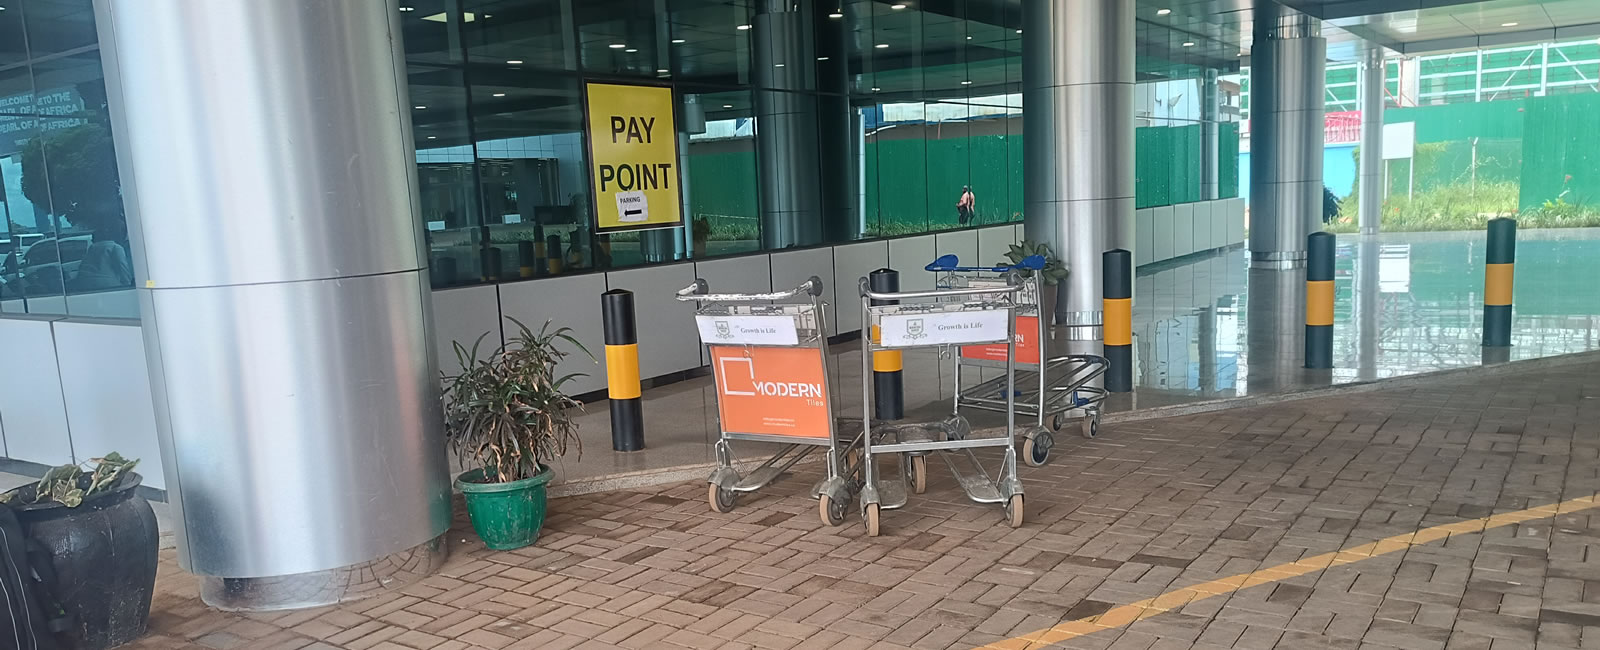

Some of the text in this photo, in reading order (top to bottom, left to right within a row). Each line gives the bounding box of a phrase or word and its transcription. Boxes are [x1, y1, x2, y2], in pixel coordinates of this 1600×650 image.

[53, 91, 71, 102] THE
[610, 116, 655, 144] PAY
[599, 163, 672, 192] POINT
[620, 196, 641, 204] PARKING
[938, 323, 962, 331] Growth
[752, 381, 822, 398] MODERN
